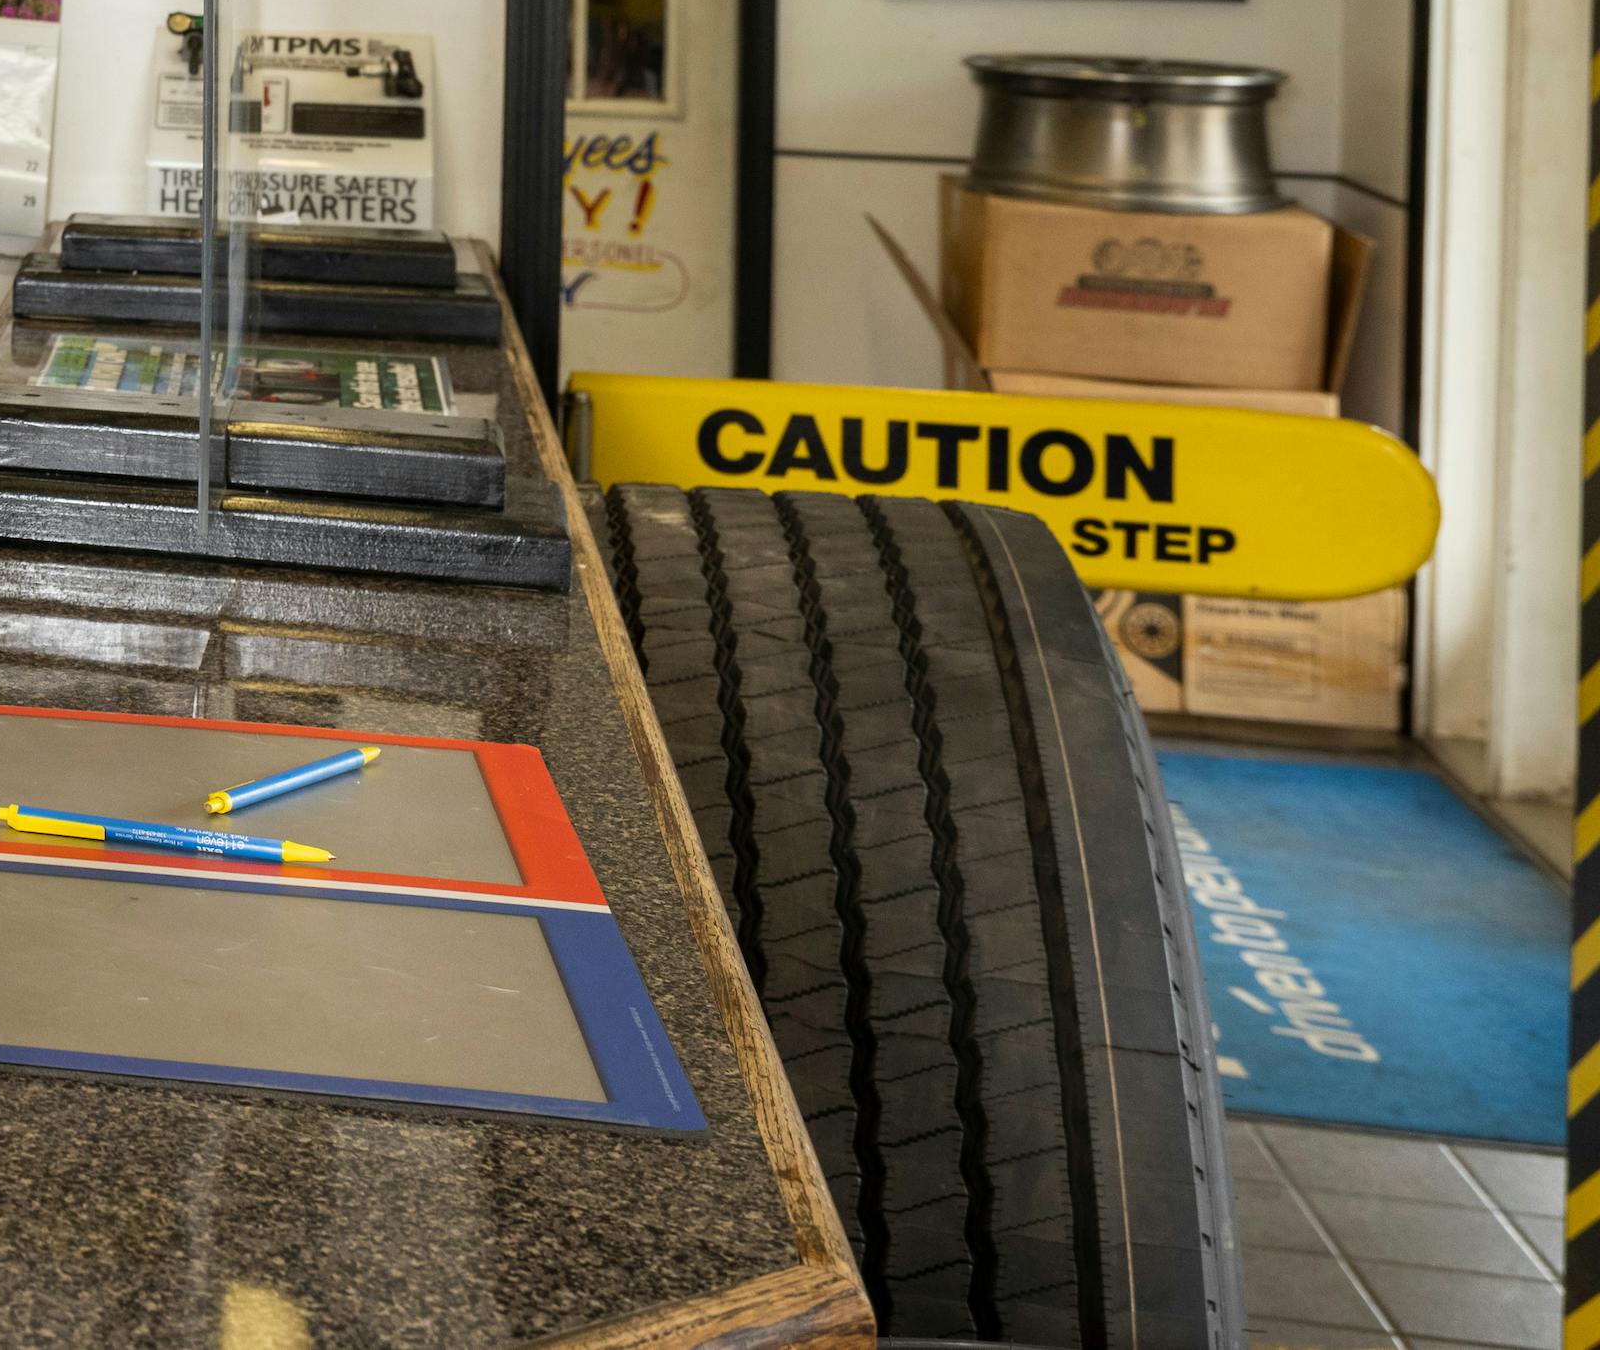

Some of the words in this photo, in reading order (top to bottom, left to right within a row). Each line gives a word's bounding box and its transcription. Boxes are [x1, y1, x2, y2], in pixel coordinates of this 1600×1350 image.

[268, 36, 362, 57] TPMS
[159, 167, 203, 190] TIRE
[333, 176, 418, 199] SAFETY
[23, 194, 38, 208] 29
[696, 408, 1176, 504] CAUTION
[1071, 516, 1237, 566] STEP
[195, 834, 246, 851] e11even
